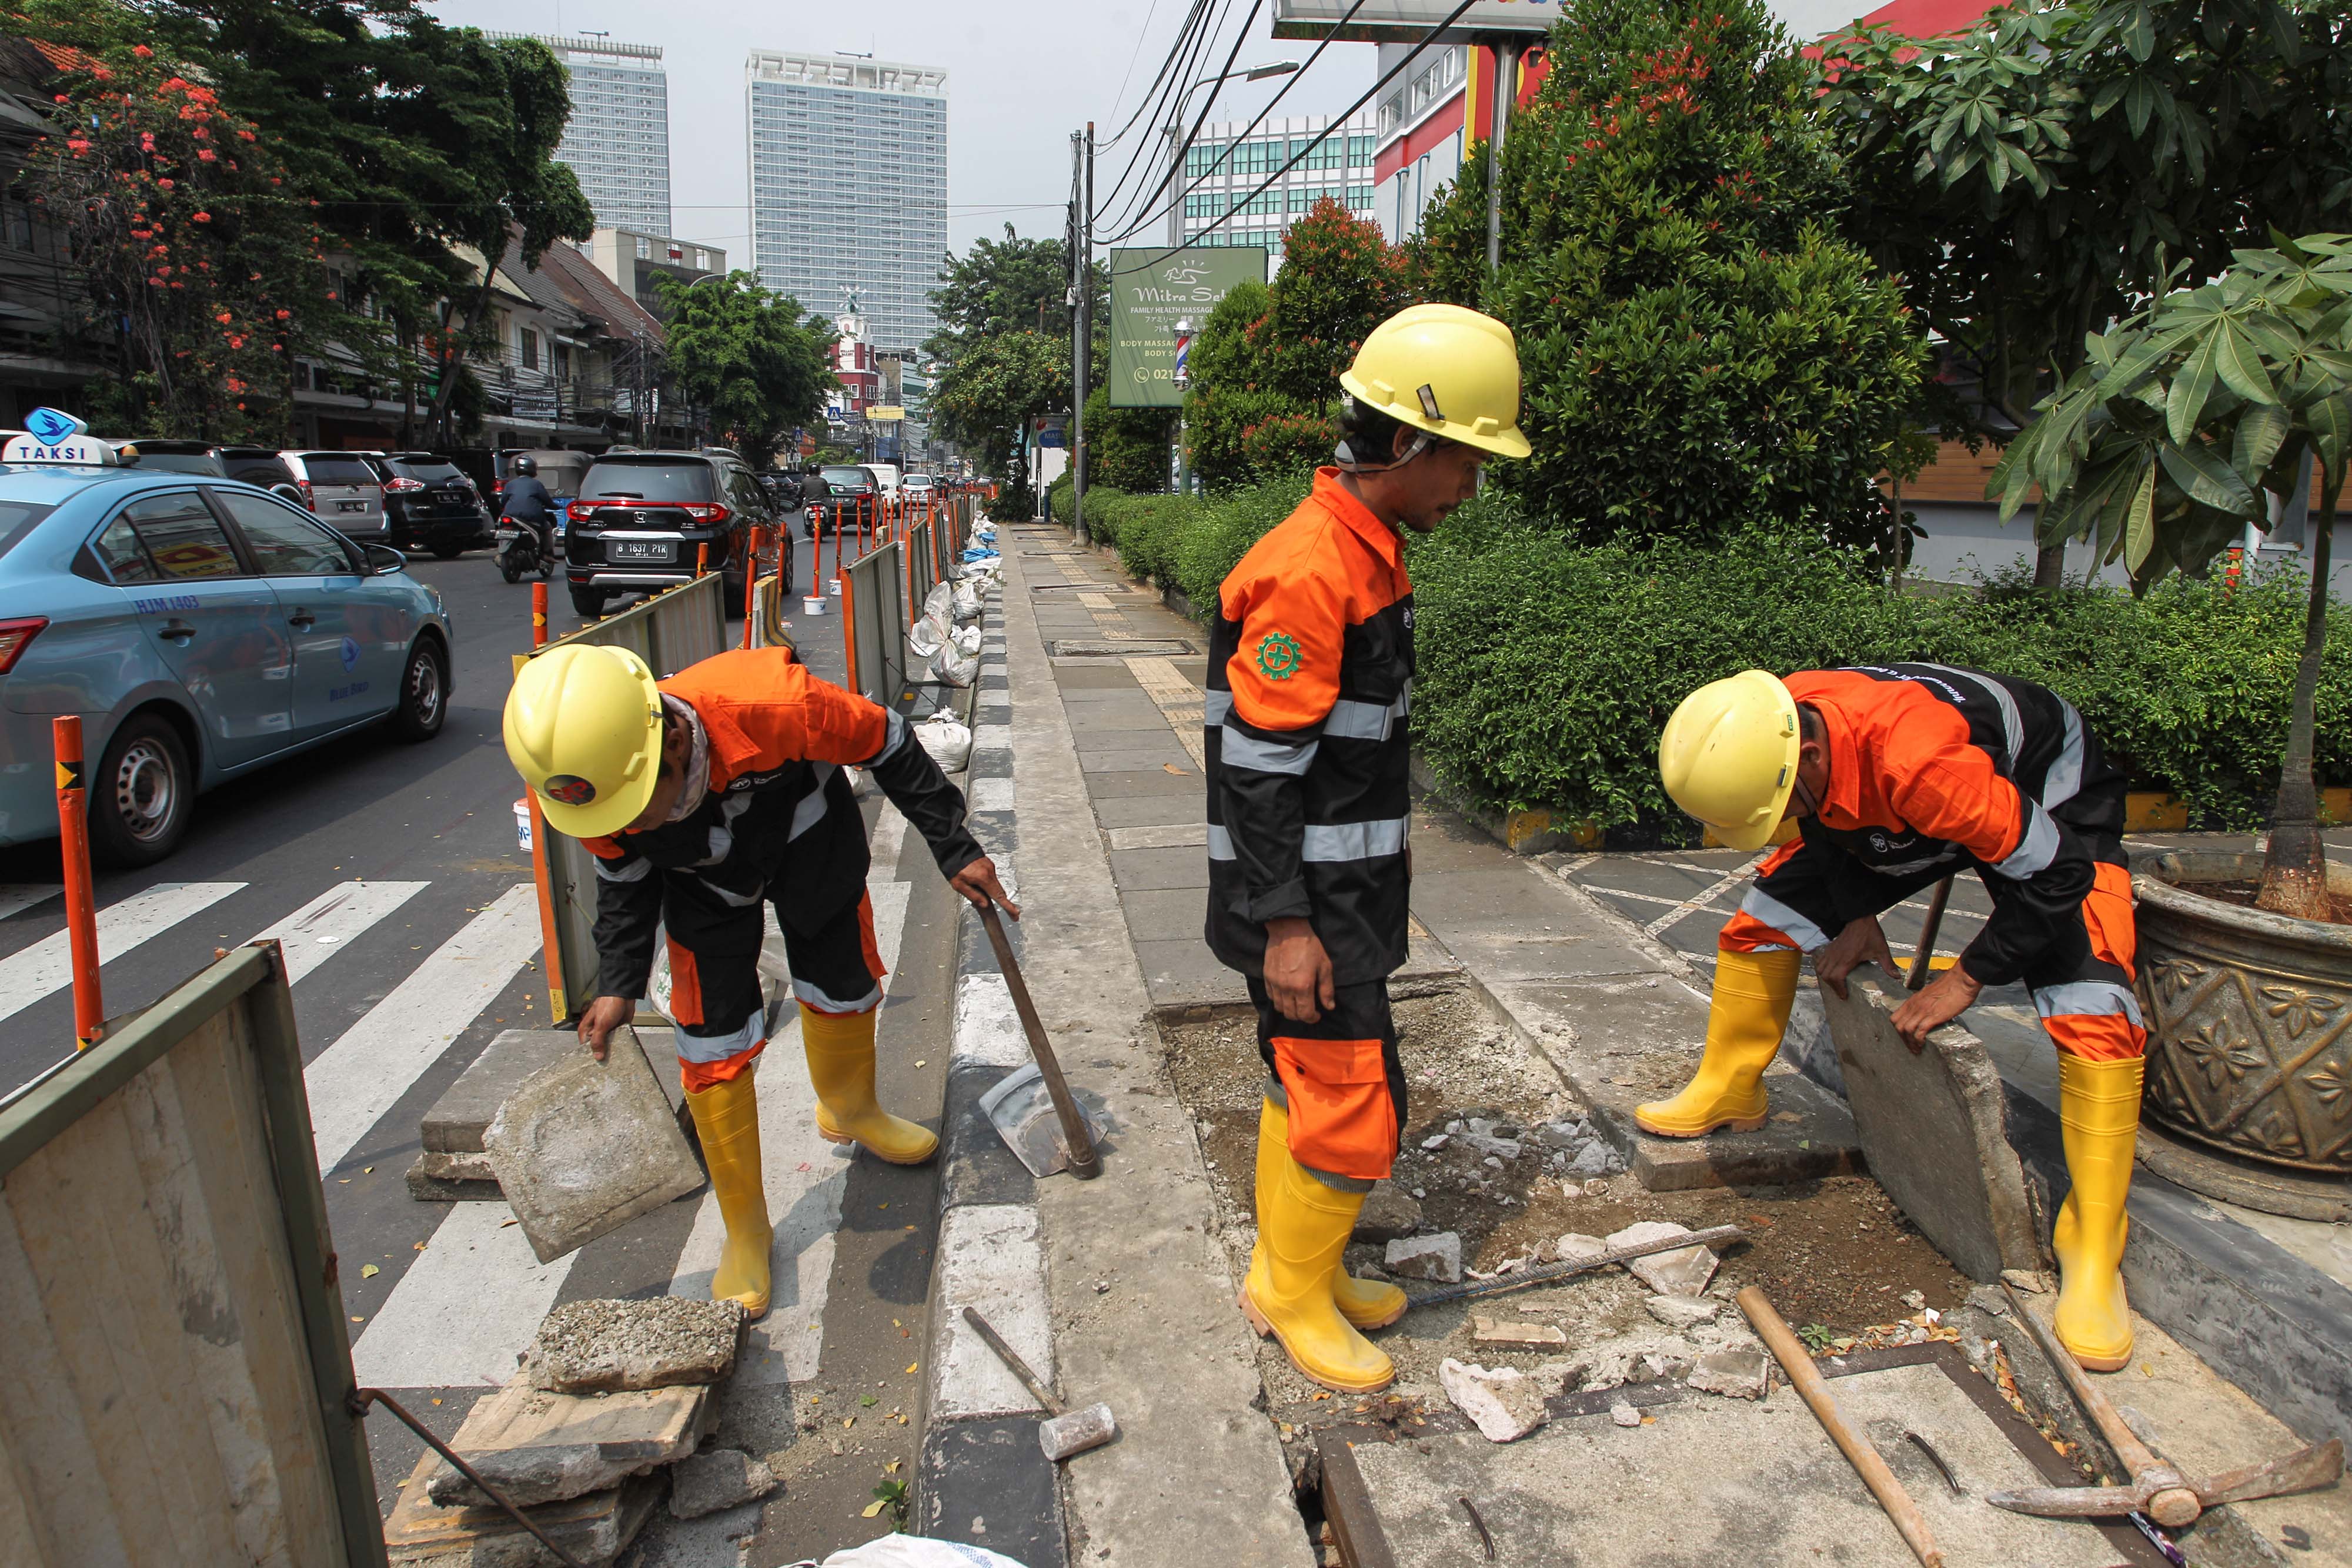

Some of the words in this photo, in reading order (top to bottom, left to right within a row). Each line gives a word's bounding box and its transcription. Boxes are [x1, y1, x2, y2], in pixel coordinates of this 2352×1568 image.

[1131, 287, 1186, 302] Mitra
[19, 447, 85, 460] TAKSI
[618, 543, 623, 553] B
[629, 543, 646, 553] 1637
[652, 543, 666, 553] PYR
[135, 597, 169, 615] HJM
[169, 594, 200, 610] 1403
[329, 687, 349, 703] BLUE
